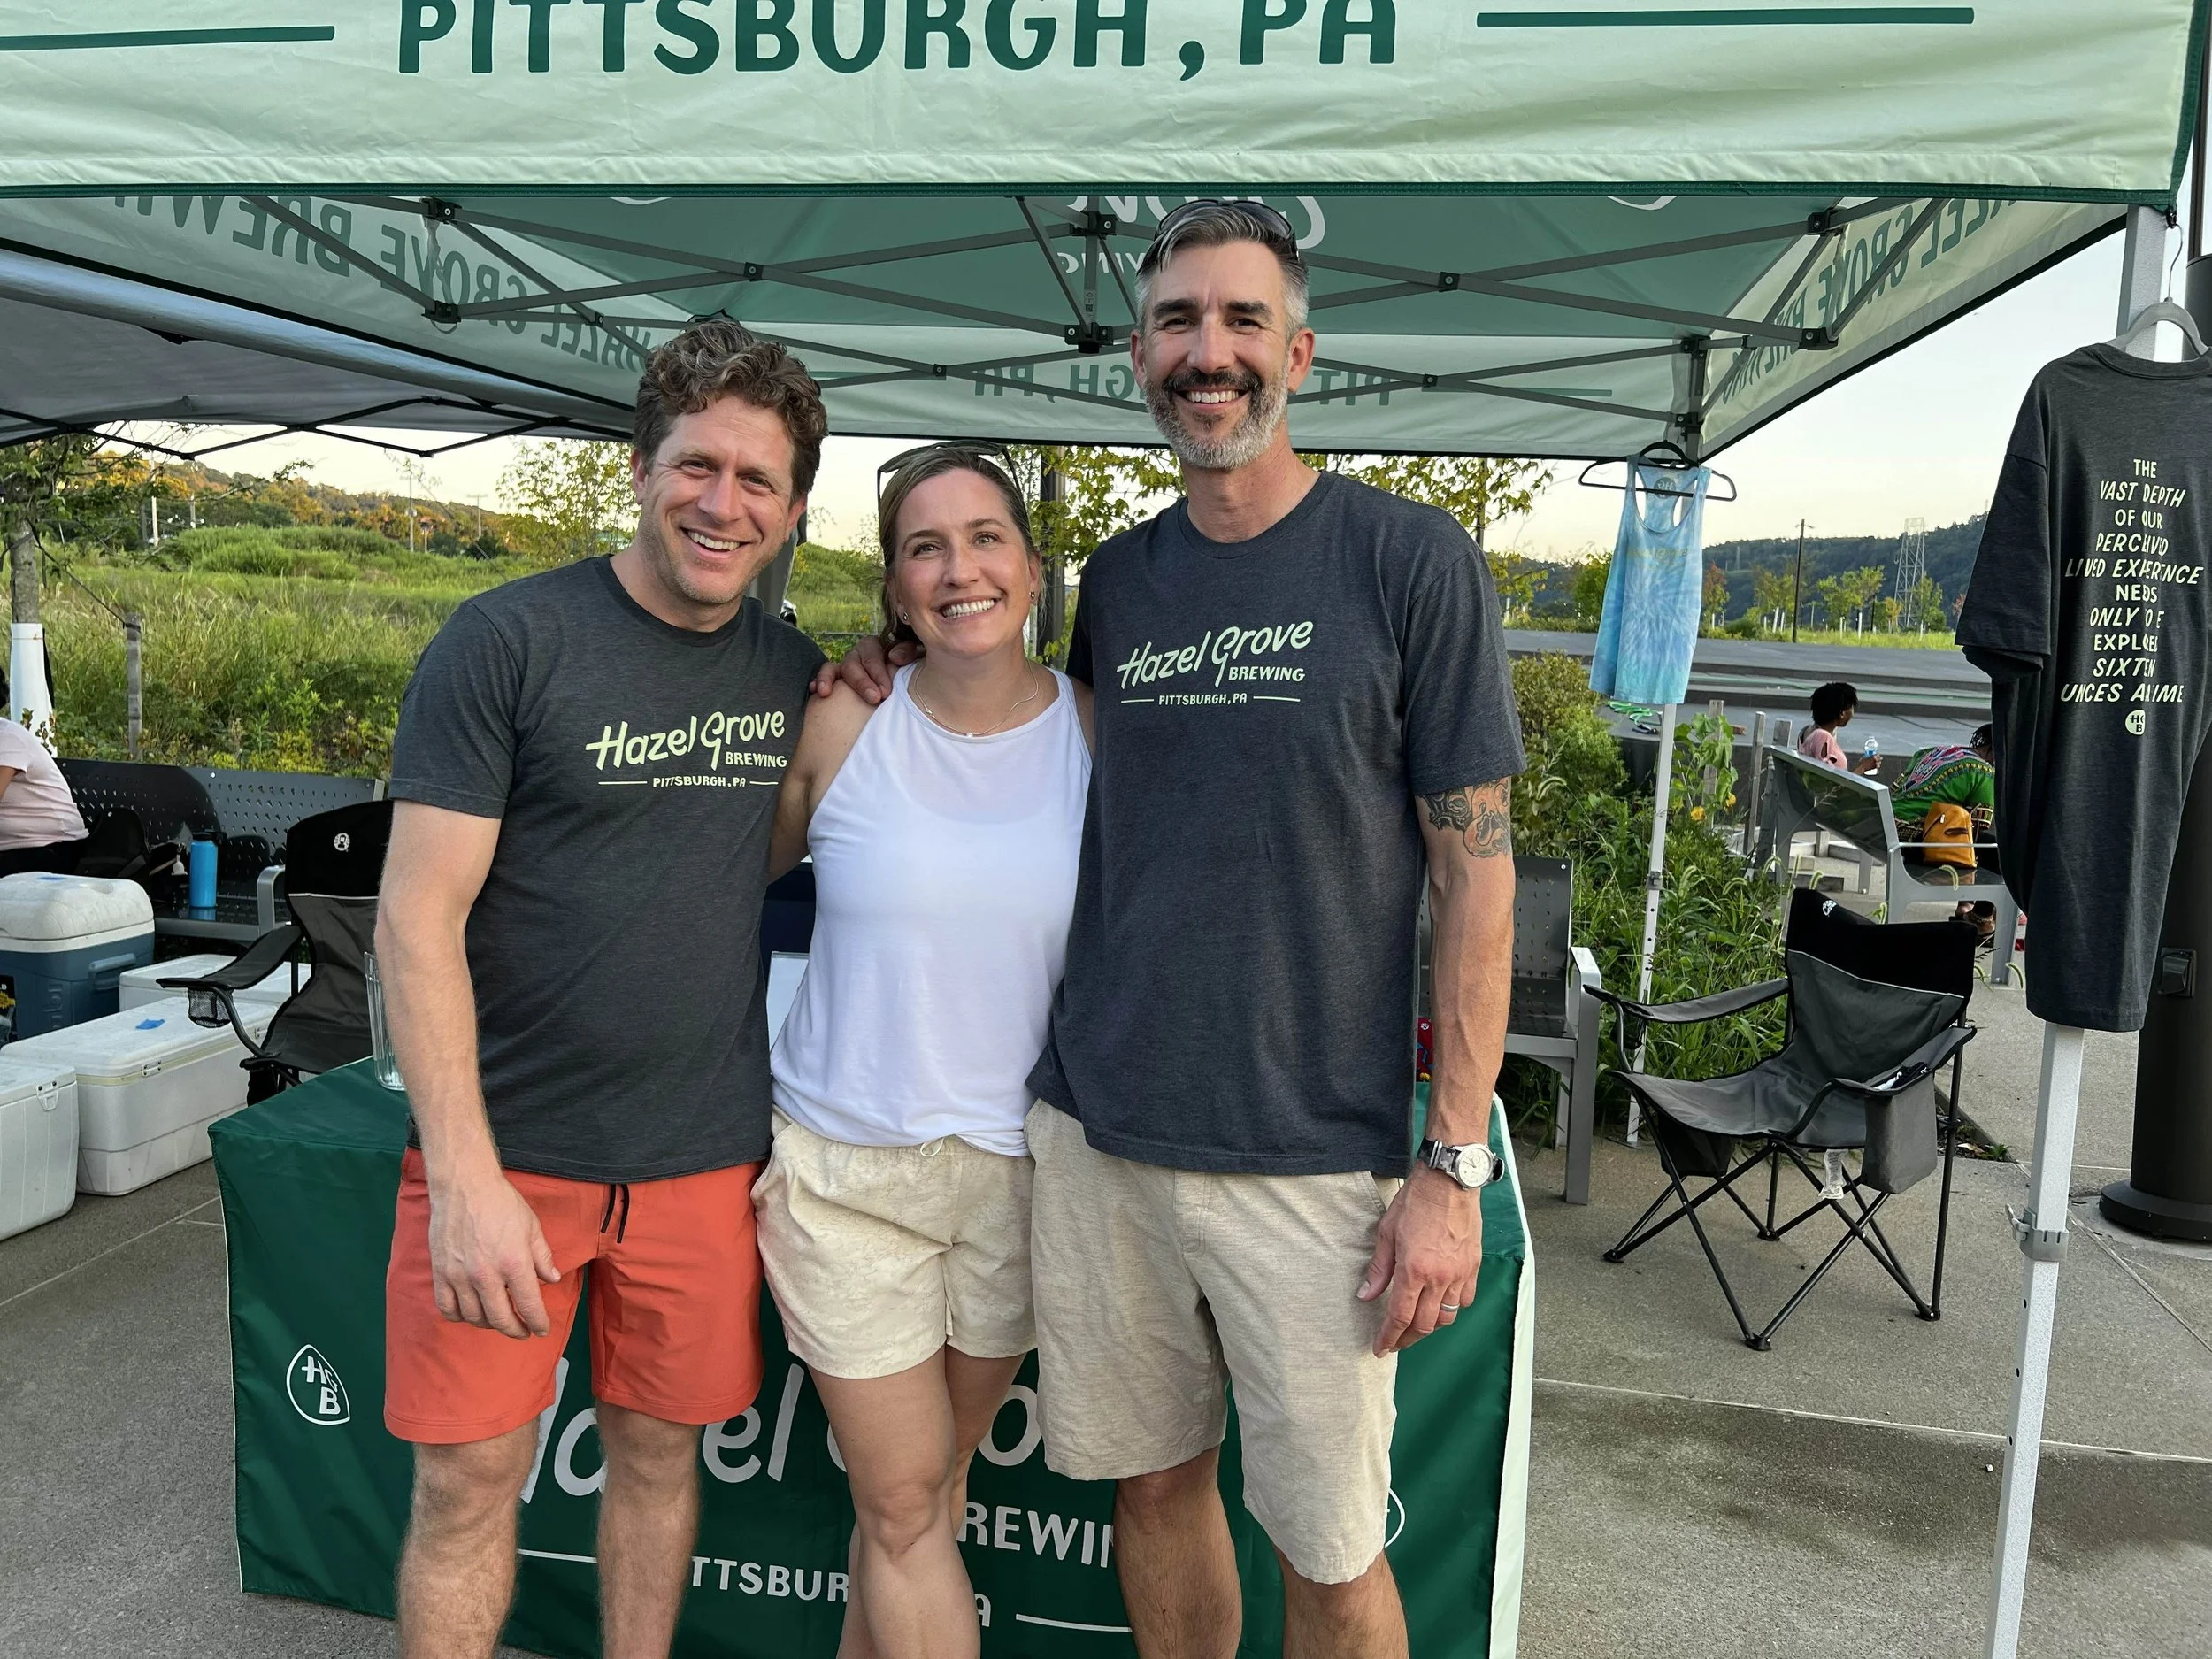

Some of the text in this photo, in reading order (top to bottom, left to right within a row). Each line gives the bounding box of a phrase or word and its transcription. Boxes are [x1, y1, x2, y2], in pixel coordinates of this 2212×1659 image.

[2133, 458, 2157, 479] THE
[2100, 480, 2186, 508] VAST DEPTH
[2115, 509, 2162, 529] OF OUR
[2090, 607, 2140, 626] ONLY
[1116, 621, 1314, 690] Hazel Grove
[1228, 666, 1306, 682] BREWING
[2060, 683, 2124, 703] UNCES
[585, 710, 786, 771] Hazel Grove
[725, 751, 788, 769] BREWING
